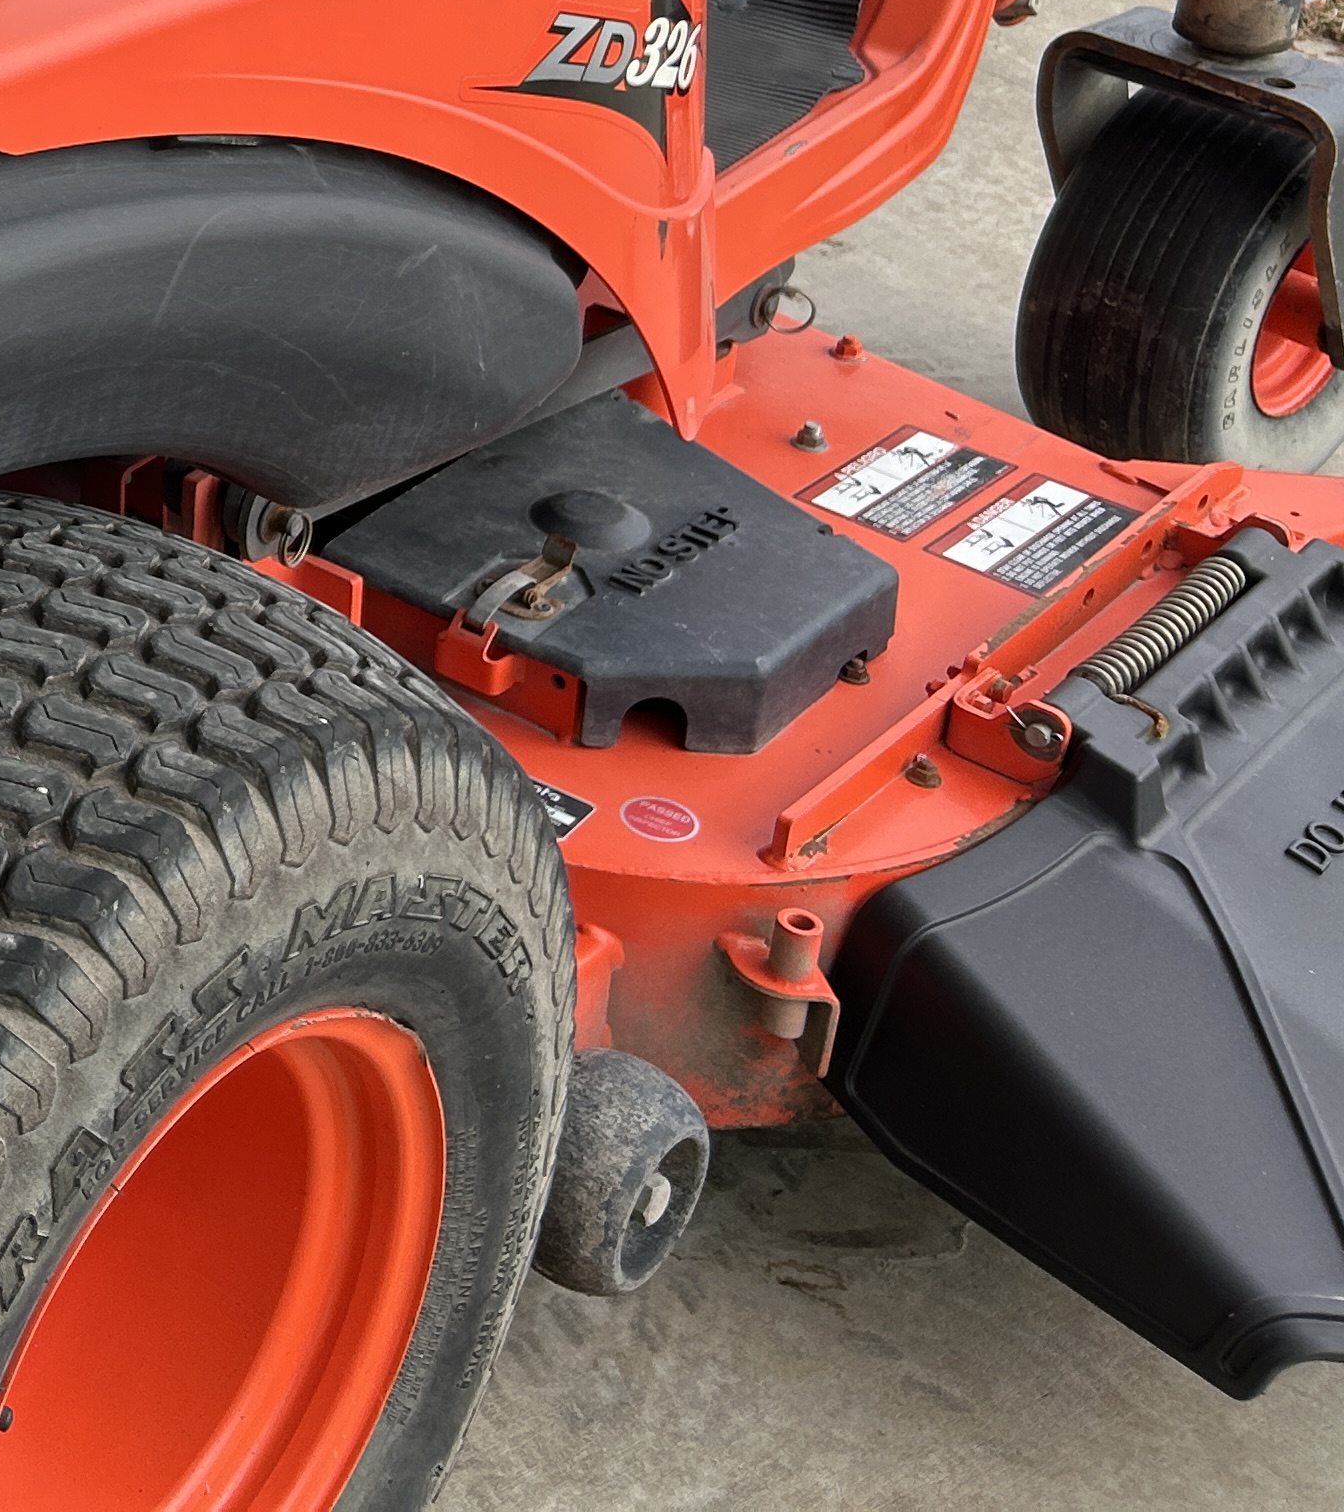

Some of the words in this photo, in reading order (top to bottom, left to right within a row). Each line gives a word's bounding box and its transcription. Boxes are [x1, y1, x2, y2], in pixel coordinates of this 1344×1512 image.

[522, 11, 703, 94] ZD326
[1223, 233, 1291, 431] CARLISLE
[608, 559, 672, 595] NO
[656, 506, 740, 563] STEP
[639, 800, 691, 824] PASSED
[280, 870, 534, 997] MASTER
[133, 1020, 228, 1131] SERVICE
[236, 971, 291, 1023] CALL
